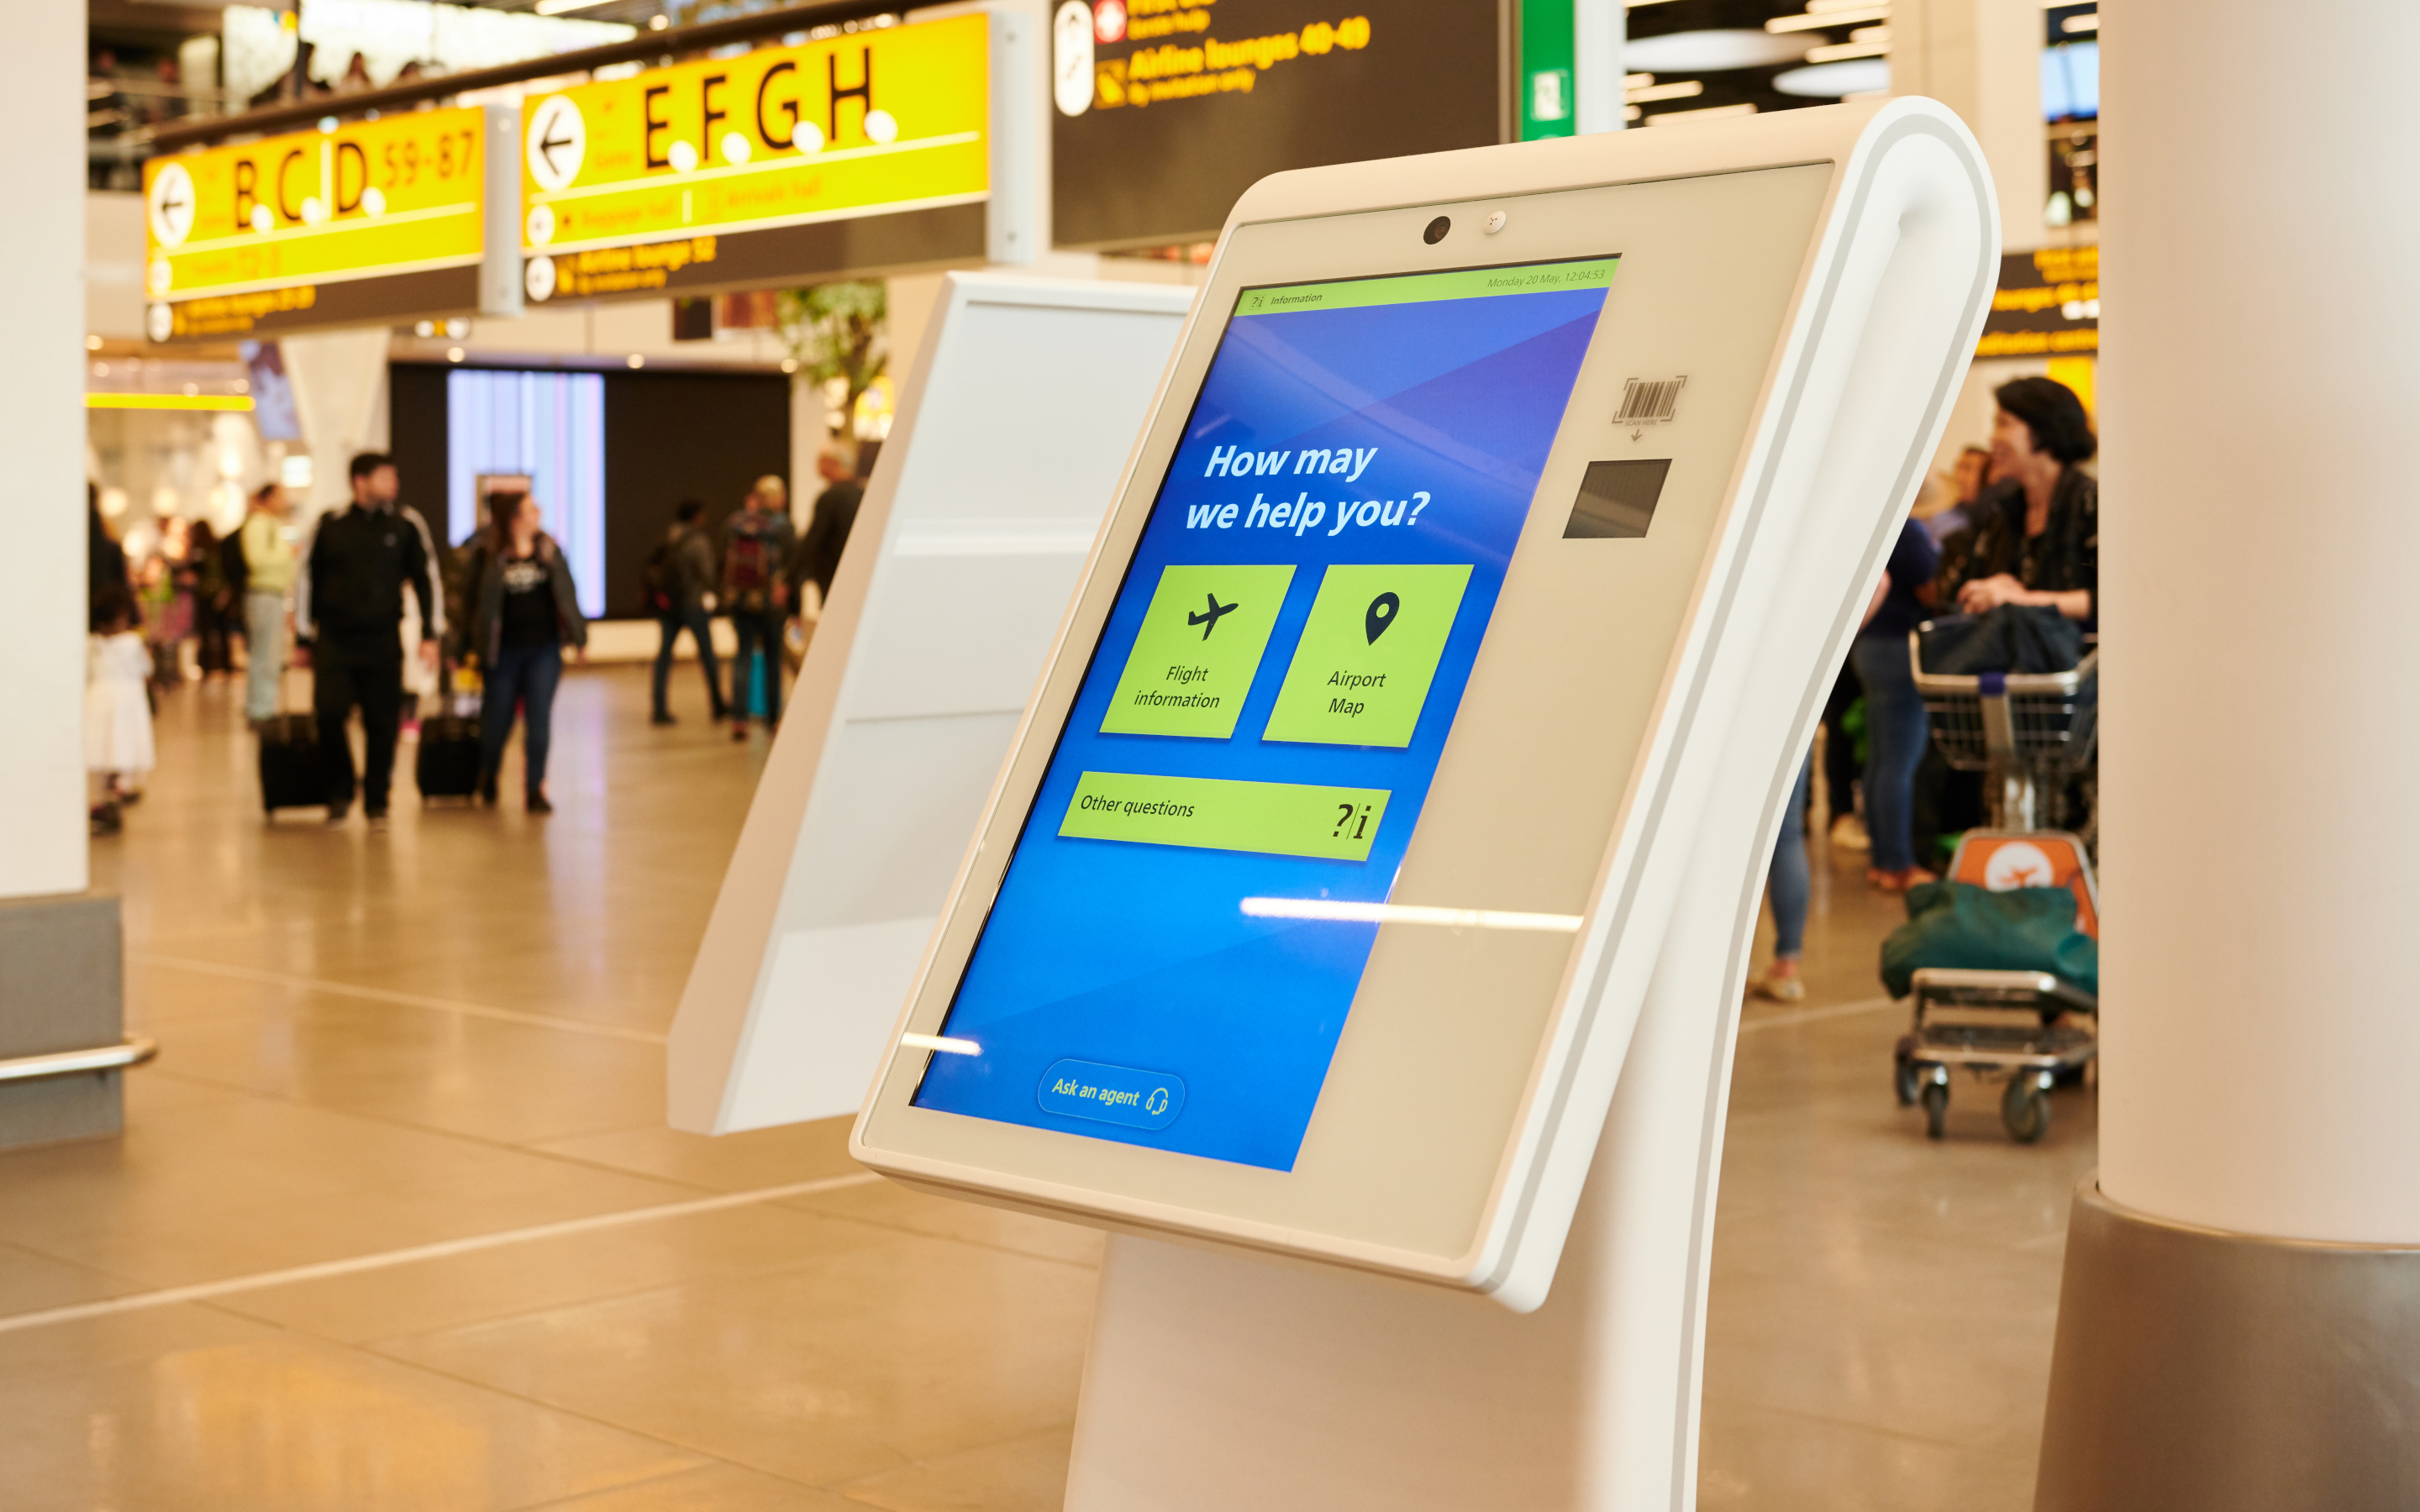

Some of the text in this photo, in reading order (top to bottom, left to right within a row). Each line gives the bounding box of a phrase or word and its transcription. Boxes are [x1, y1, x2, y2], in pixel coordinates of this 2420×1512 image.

[644, 46, 872, 170] E F G H
[1487, 269, 1606, 288] Monday 20 May, 12:04:53
[1270, 293, 1323, 306] Information
[1204, 445, 1379, 482] How may
[1186, 491, 1431, 536] we help you?
[1165, 665, 1209, 685] Flight
[1327, 670, 1386, 691] Airport
[1134, 690, 1220, 709] information
[1328, 698, 1365, 718] Map
[1080, 795, 1195, 818] Other questions
[1051, 1079, 1140, 1106] Ask an agent
